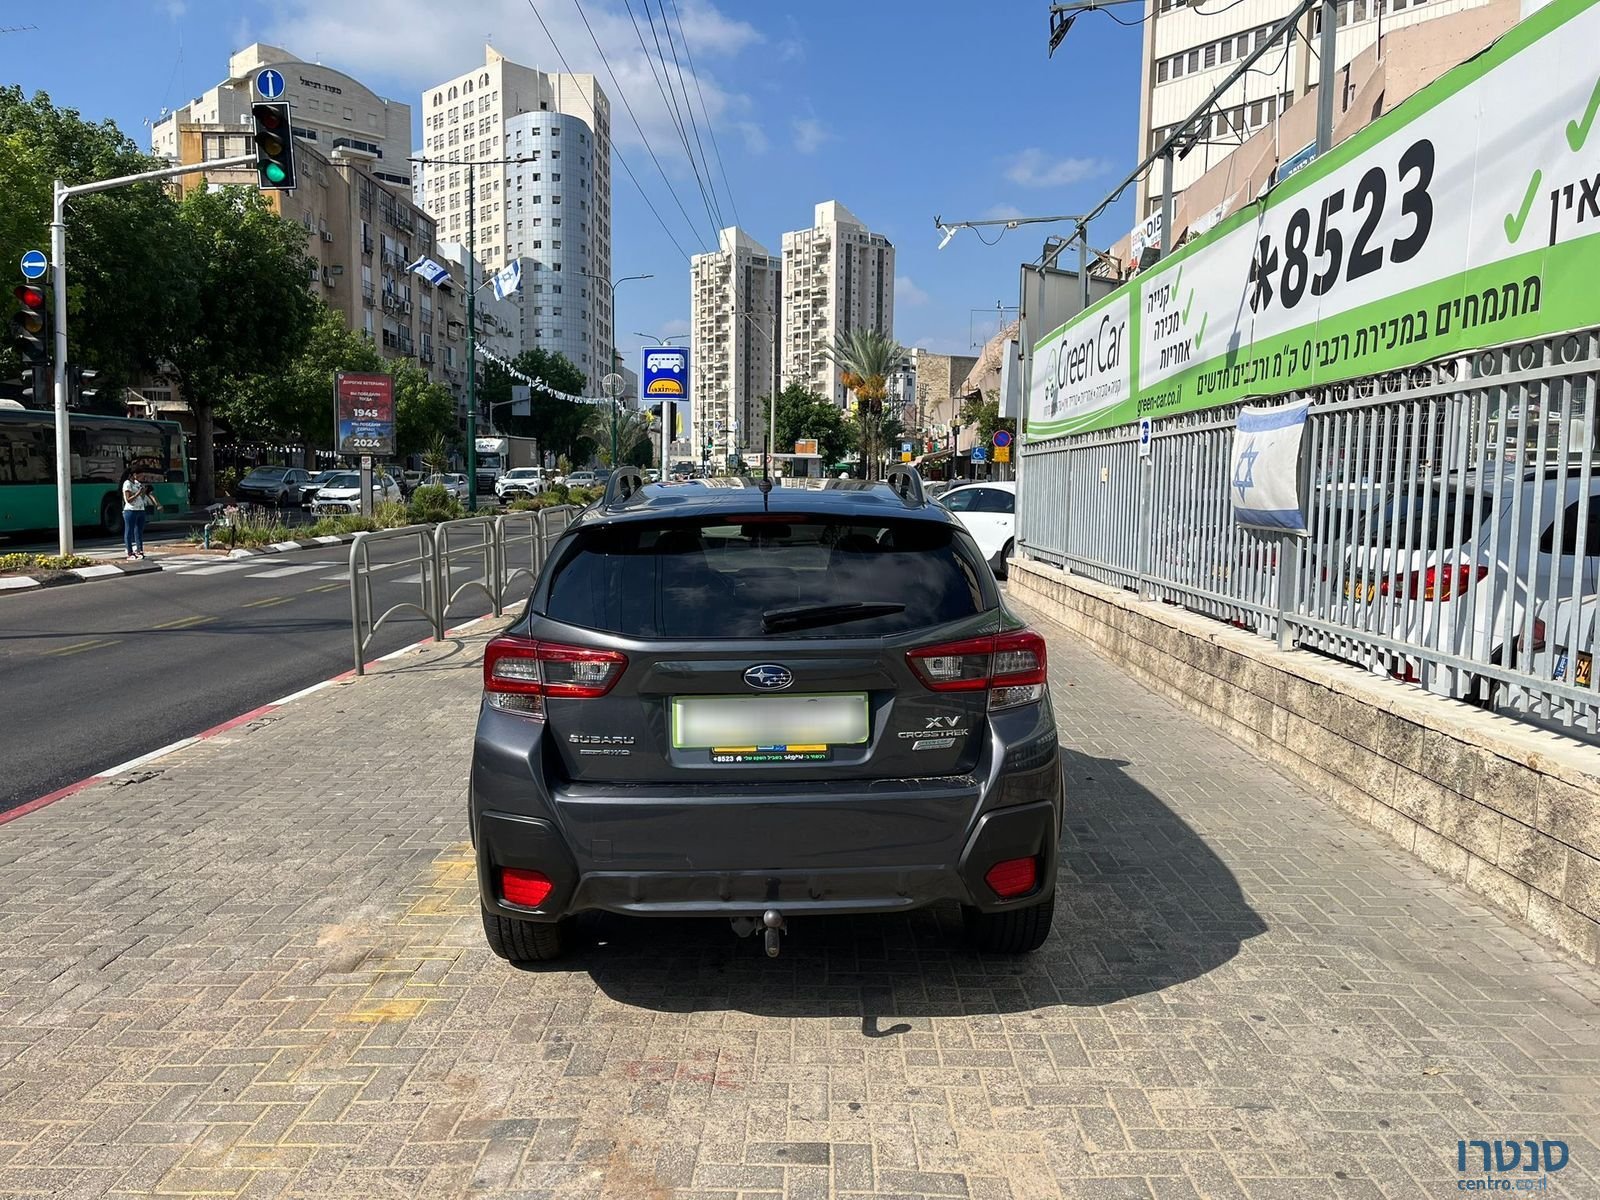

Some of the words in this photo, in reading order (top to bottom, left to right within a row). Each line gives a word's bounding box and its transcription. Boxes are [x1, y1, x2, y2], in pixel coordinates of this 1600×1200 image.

[1147, 284, 1170, 314] קנייה
[1435, 275, 1542, 336] מתמחים
[1153, 310, 1180, 342] מכירה
[1353, 309, 1428, 358] במכירת
[1058, 339, 1094, 390] Green
[1097, 314, 1125, 373] Car
[1159, 338, 1192, 370] אחריות
[1302, 339, 1312, 372] 0
[1316, 333, 1350, 367] רכבי
[1196, 367, 1230, 396] חדשים
[1232, 355, 1270, 387] ורכבים
[353, 408, 378, 417] 1945
[1137, 383, 1182, 417] green-car.co.il
[353, 439, 380, 447] 2024
[897, 728, 969, 738] CROSSTREK
[925, 715, 961, 729] XV
[568, 734, 635, 744] SUBARU
